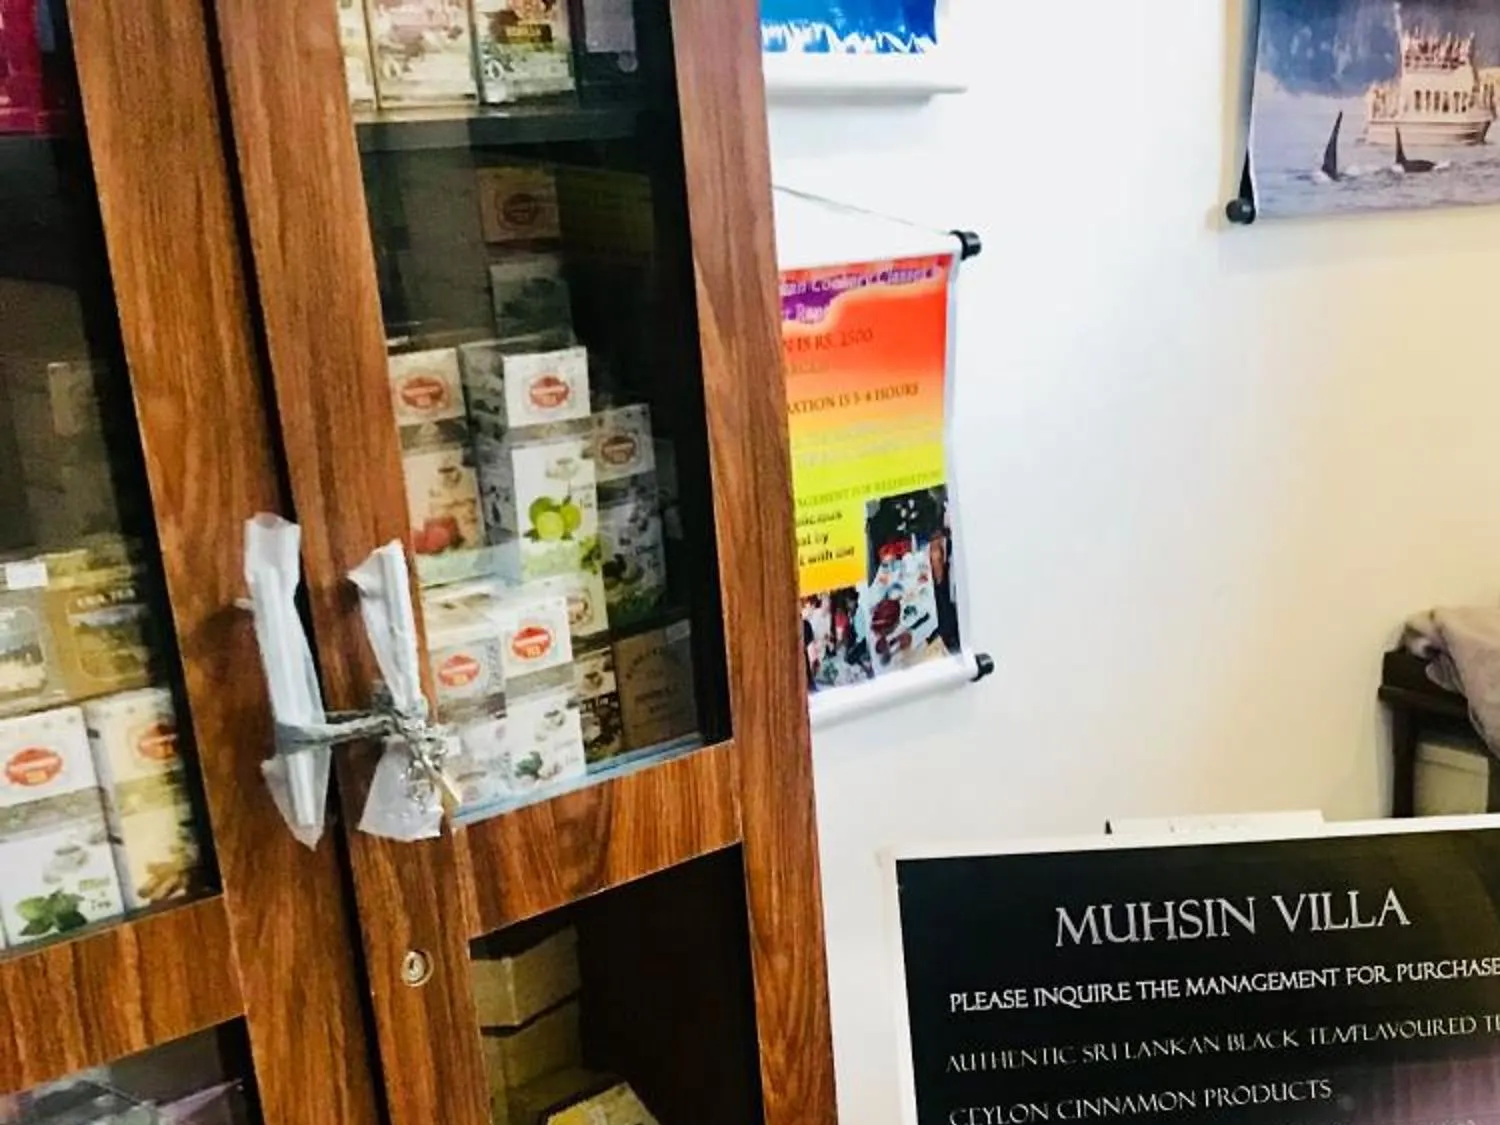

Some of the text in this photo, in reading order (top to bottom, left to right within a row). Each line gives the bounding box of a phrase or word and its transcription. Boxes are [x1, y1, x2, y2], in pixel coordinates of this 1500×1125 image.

[1053, 887, 1410, 947] MUHSIN VILLA
[950, 988, 1028, 1014] PLEASE
[1033, 981, 1131, 1008] INQUIRE
[1136, 978, 1180, 1001] THE
[1184, 967, 1341, 998] MANAGEMENT
[1346, 964, 1391, 987] FOR
[946, 1045, 1077, 1073] AUTHENTIC
[1082, 1042, 1118, 1063] SRI
[1124, 1035, 1220, 1060] LANKAN
[1227, 1029, 1298, 1052] BLACK
[1056, 1089, 1196, 1120] CINNAMON
[1203, 1078, 1333, 1108] PRODUCTS
